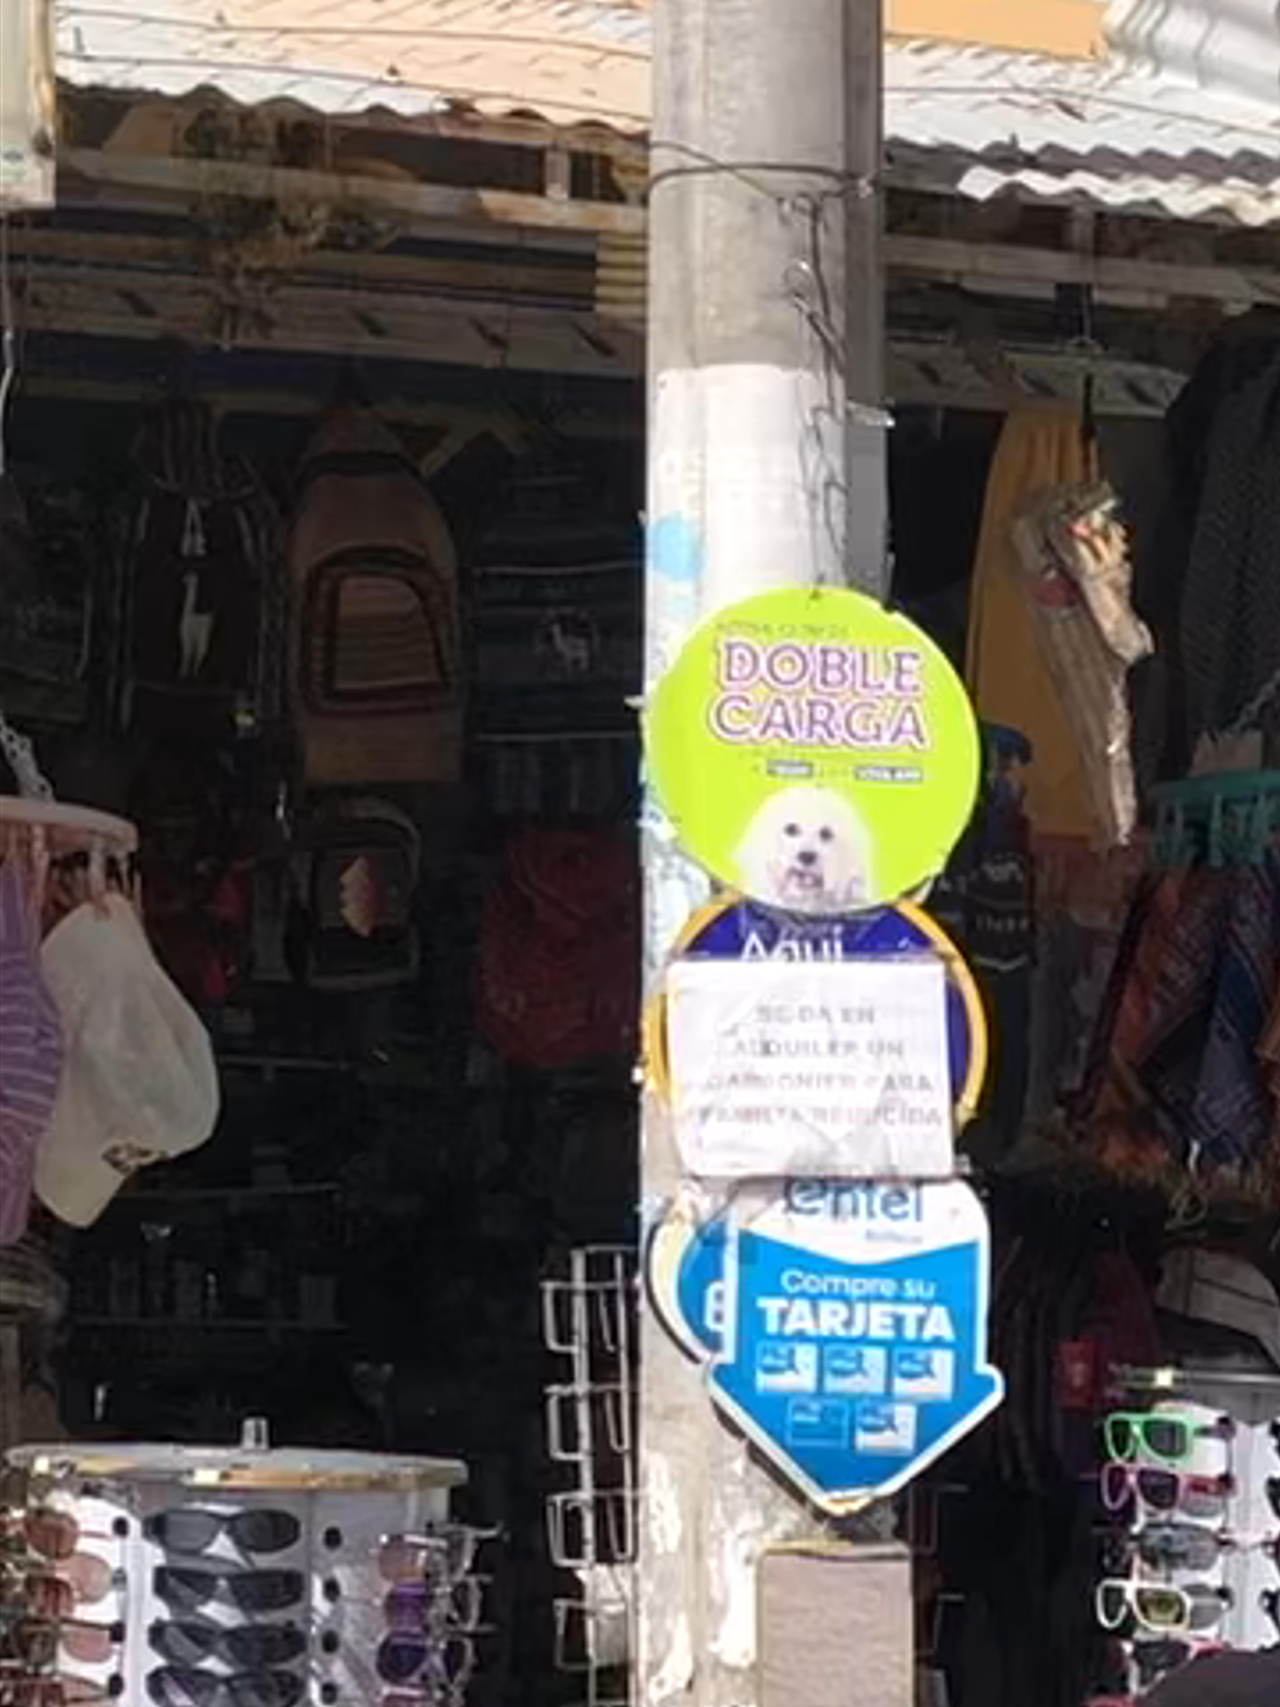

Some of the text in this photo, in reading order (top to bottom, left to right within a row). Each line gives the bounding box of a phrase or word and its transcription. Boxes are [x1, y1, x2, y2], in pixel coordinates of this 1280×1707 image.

[721, 639, 923, 694] DOBLE
[714, 693, 927, 746] CARGA
[784, 1177, 923, 1223] entel
[780, 1268, 938, 1300] Compre su
[755, 1296, 956, 1342] TARJETA
